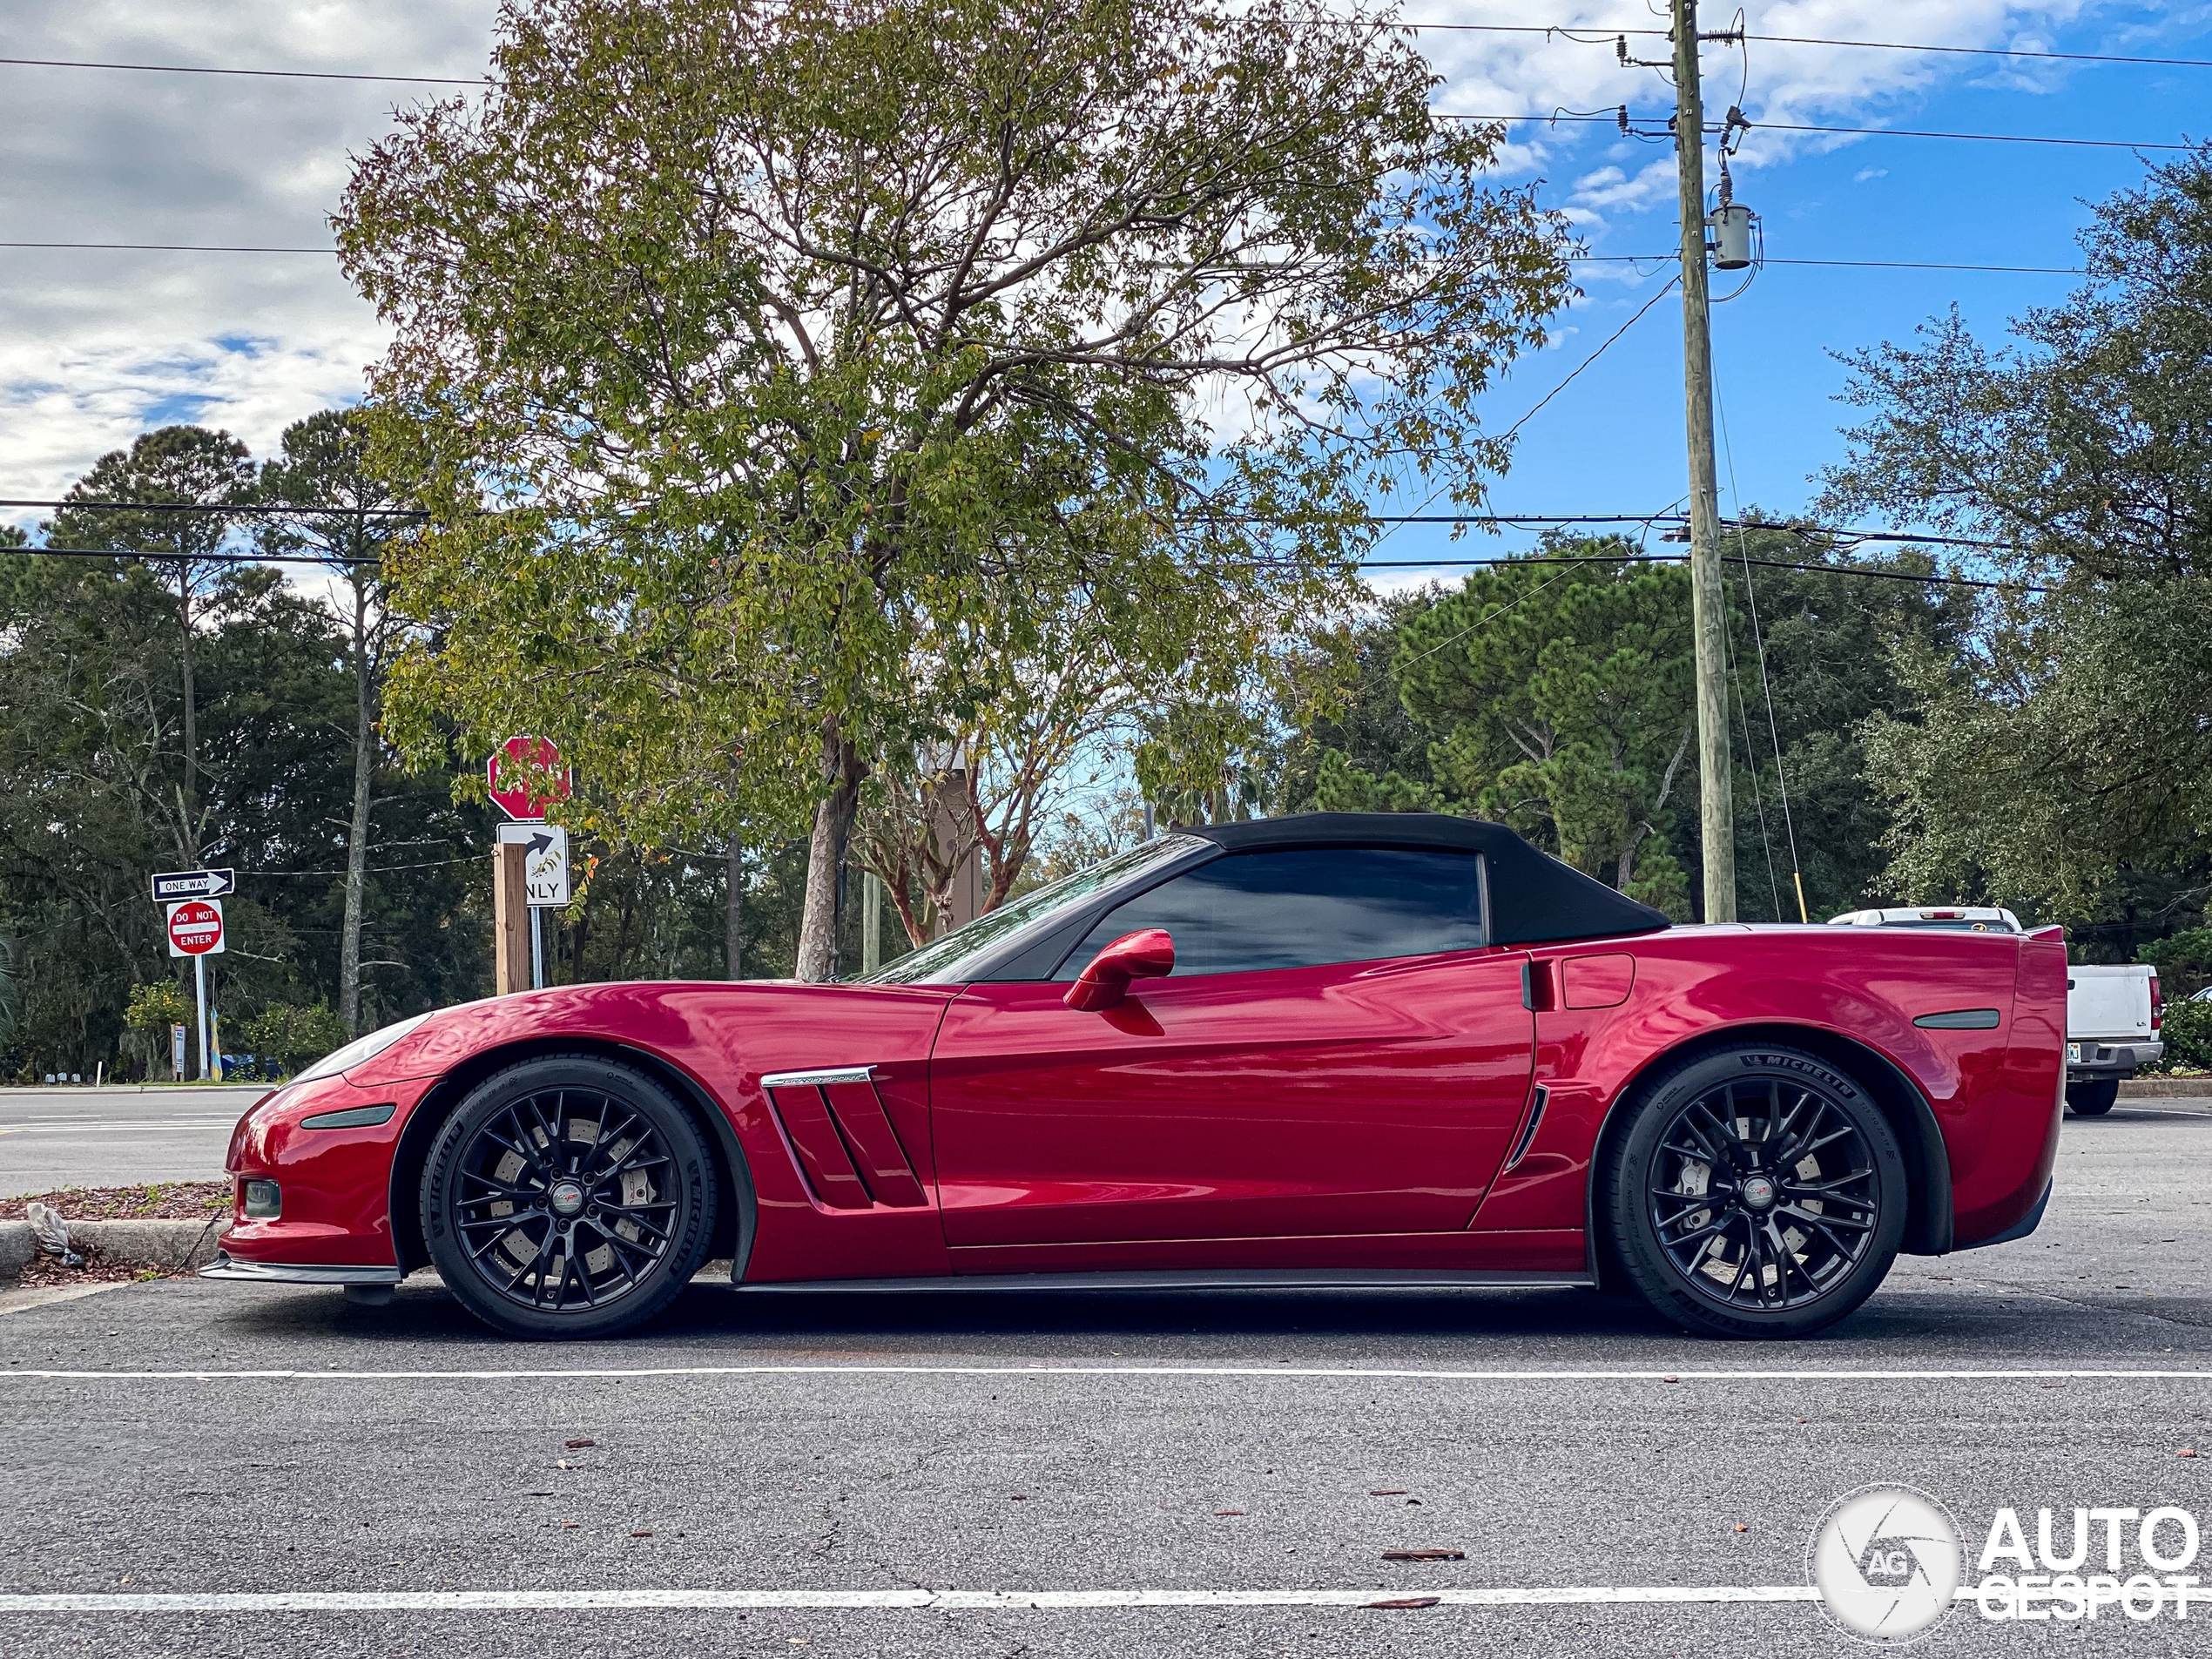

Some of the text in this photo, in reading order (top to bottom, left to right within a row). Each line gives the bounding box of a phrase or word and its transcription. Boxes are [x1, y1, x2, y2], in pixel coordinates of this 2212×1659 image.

[165, 879, 208, 891] ONE WAY
[525, 883, 559, 898] NLY
[176, 911, 214, 922] DO NOT
[180, 934, 212, 946] ENTER
[782, 1074, 865, 1085] GRAND SPORT
[1766, 1055, 1852, 1095] MICHELIN
[431, 1126, 460, 1212] MICHELIN
[673, 1185, 701, 1271] MICHELIN
